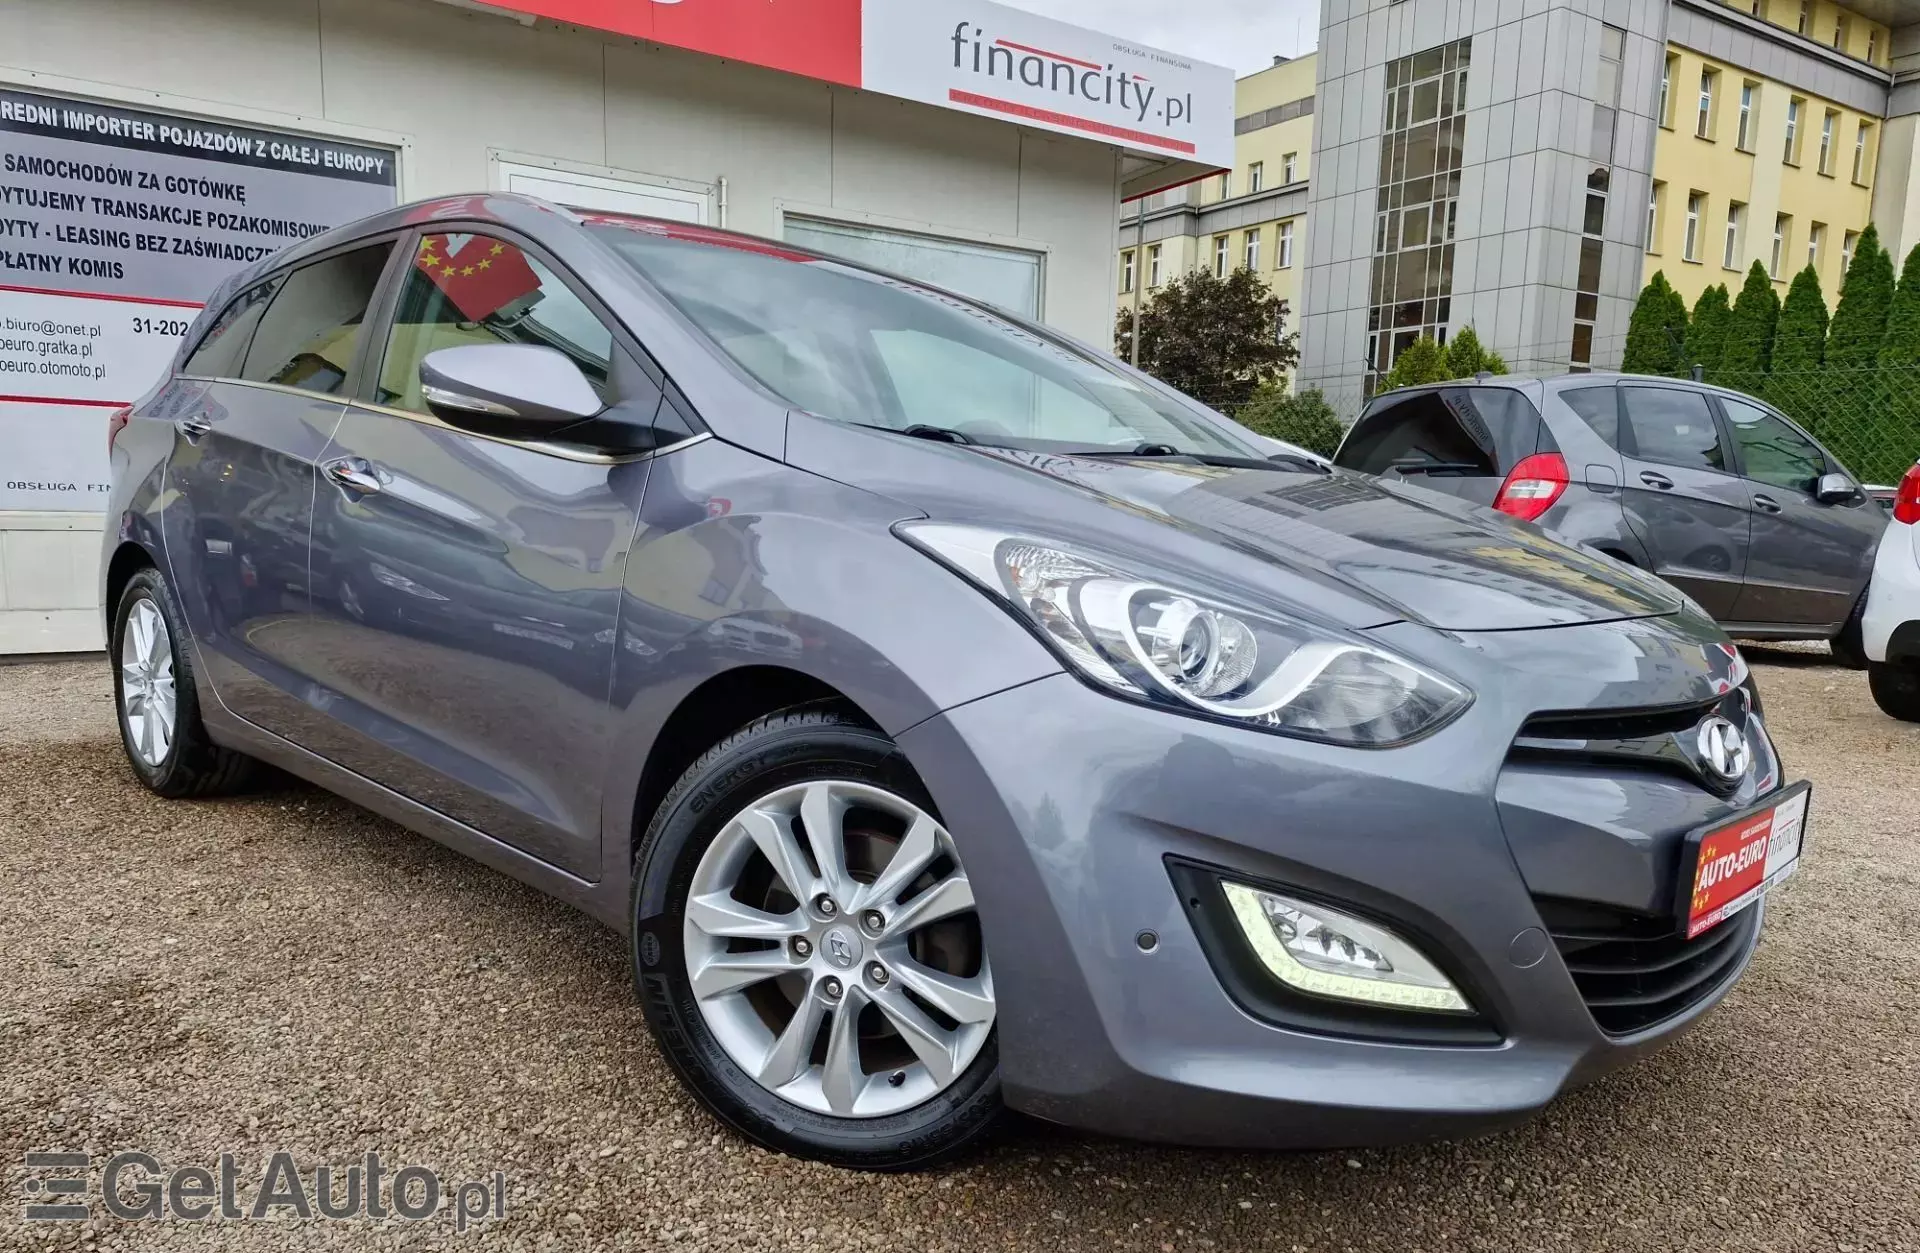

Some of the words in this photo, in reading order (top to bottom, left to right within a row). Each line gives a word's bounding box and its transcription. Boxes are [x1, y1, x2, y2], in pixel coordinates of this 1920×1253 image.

[950, 21, 1192, 126] financity.pl
[1, 101, 58, 127] REDNI
[63, 110, 155, 142] IMPORTER
[159, 124, 252, 156] POJAZDÓW
[255, 140, 267, 158] Z
[270, 142, 320, 165] CAŁEJ
[323, 151, 385, 175] EUROPY
[4, 153, 133, 187] SAMOCHODÓW
[137, 171, 160, 191] ZA
[164, 174, 246, 206] GOTÓWKĘ
[0, 185, 86, 212] YTUJEMY
[91, 196, 202, 227] TRANSAKCJE
[56, 224, 131, 250] LEASING
[136, 234, 168, 254] BEZ
[172, 238, 281, 263] ZAŚWIADCZ
[68, 257, 124, 280] KOMIS
[0, 317, 102, 337] .biuro@onet.pl
[132, 317, 189, 337] 31-202
[0, 360, 106, 380] oeuro.otomoto.pl
[7, 481, 78, 492] OBSŁUGA
[689, 750, 769, 815] ENERGY
[1697, 835, 1767, 892] AUTO-EURO
